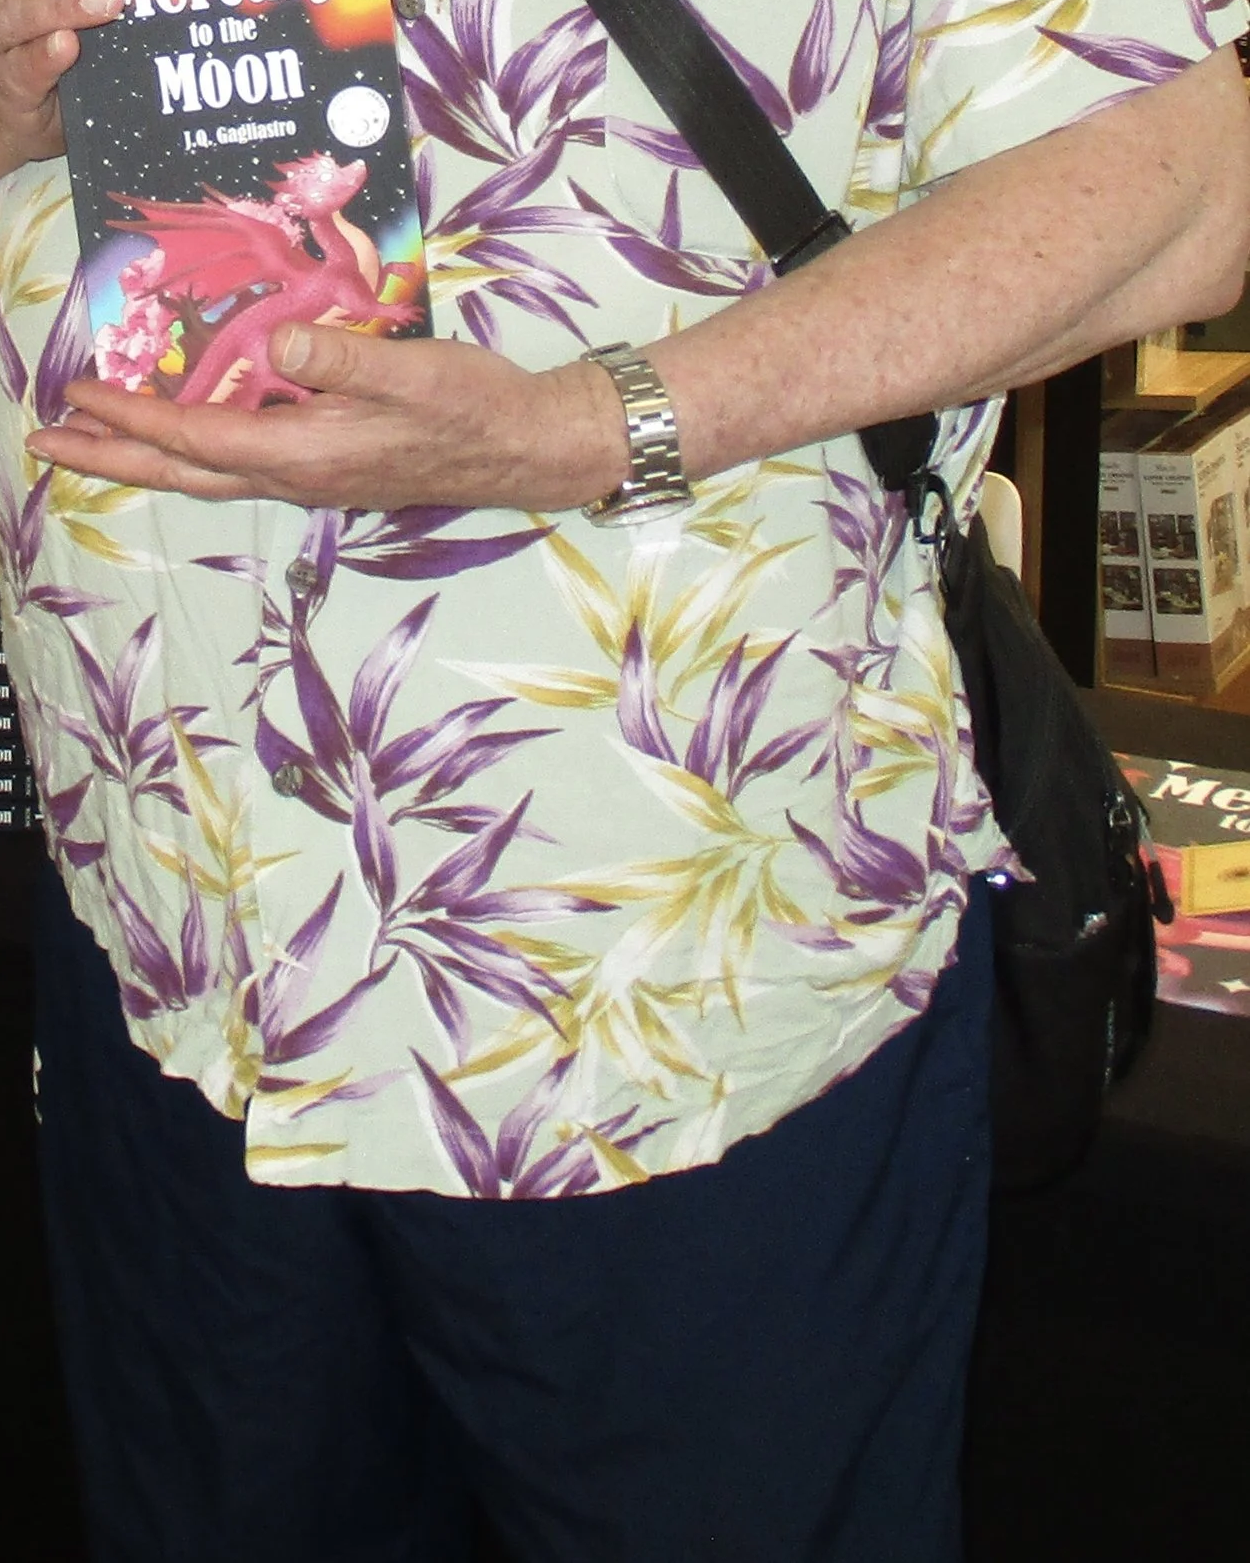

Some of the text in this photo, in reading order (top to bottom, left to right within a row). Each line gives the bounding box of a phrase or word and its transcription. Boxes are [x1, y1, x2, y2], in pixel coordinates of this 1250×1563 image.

[189, 16, 258, 48] to the
[154, 48, 304, 116] Moon
[216, 120, 297, 146] Gagliastro
